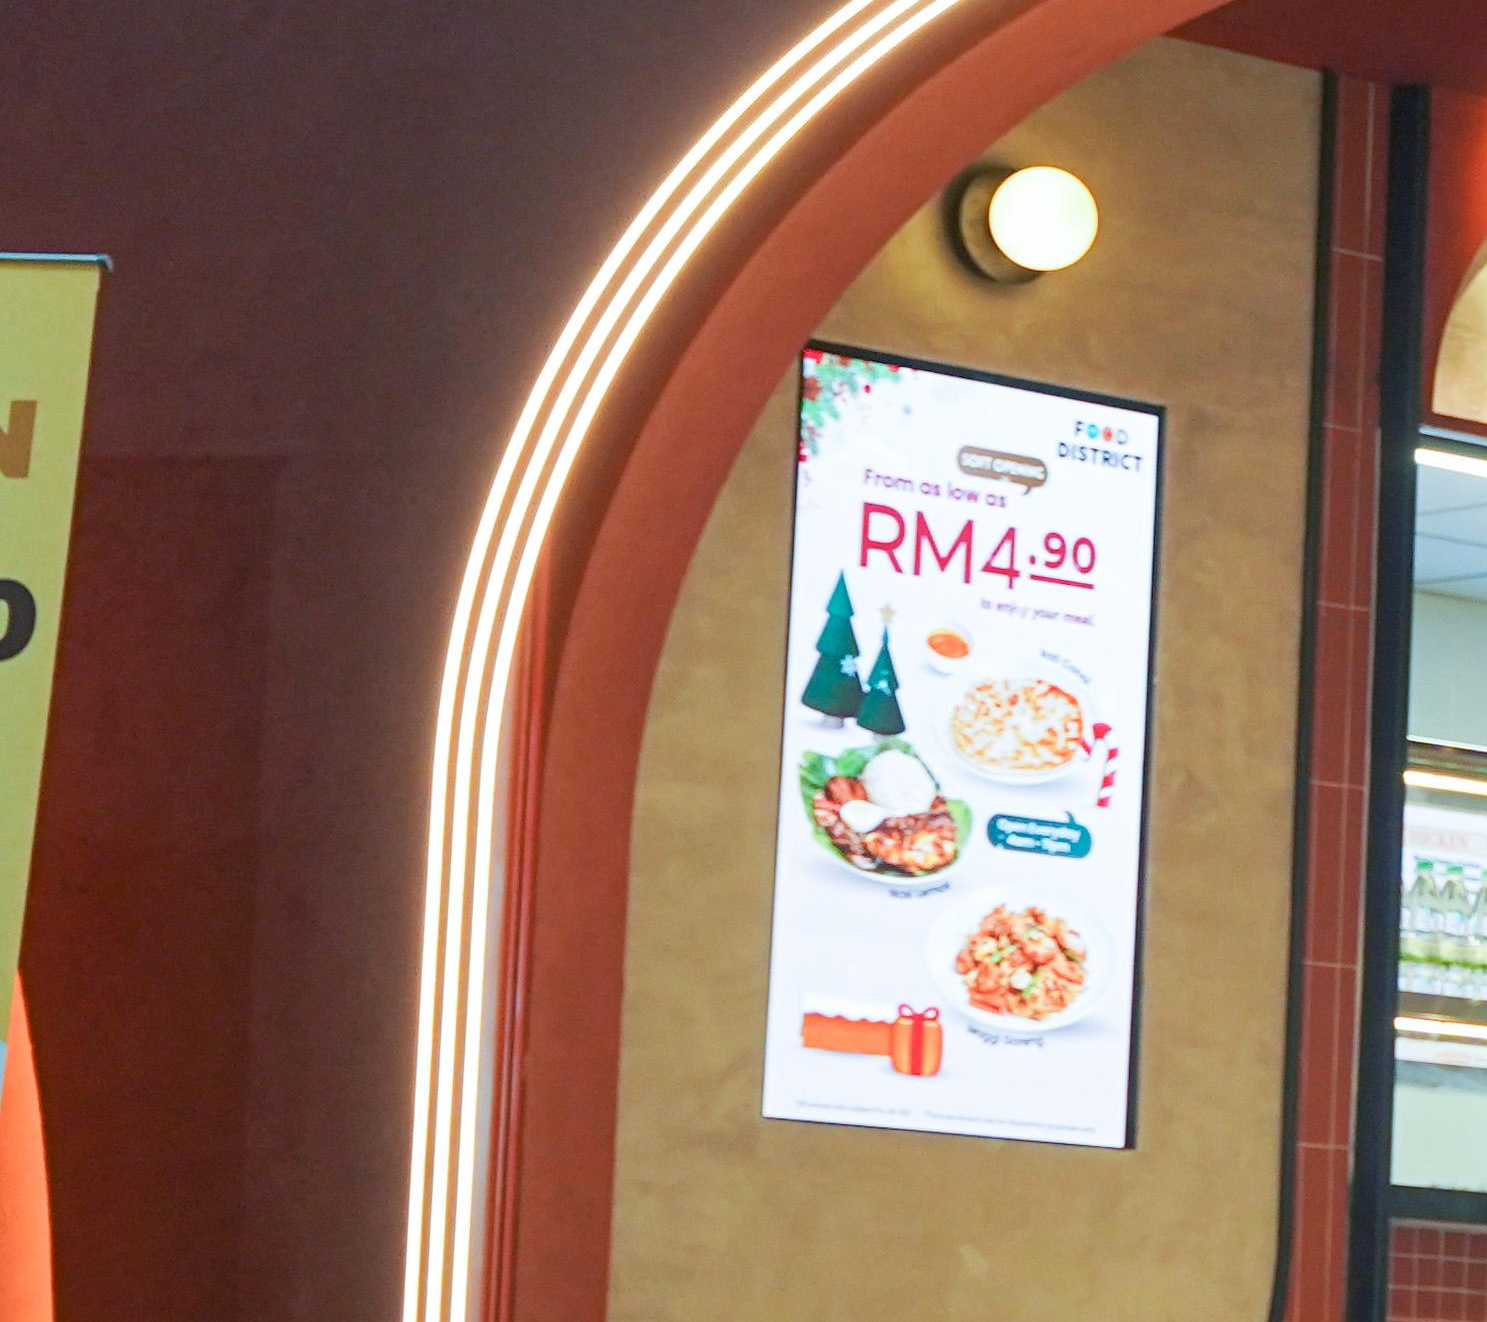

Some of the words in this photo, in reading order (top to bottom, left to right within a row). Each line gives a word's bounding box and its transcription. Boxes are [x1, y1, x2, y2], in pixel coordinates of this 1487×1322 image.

[1074, 421, 1129, 445] FOOD
[1058, 442, 1143, 472] DISTRICT
[864, 469, 914, 493] From
[919, 482, 942, 497] as
[948, 482, 979, 504] low
[985, 494, 1007, 509] as
[859, 501, 1097, 590] RM4.90
